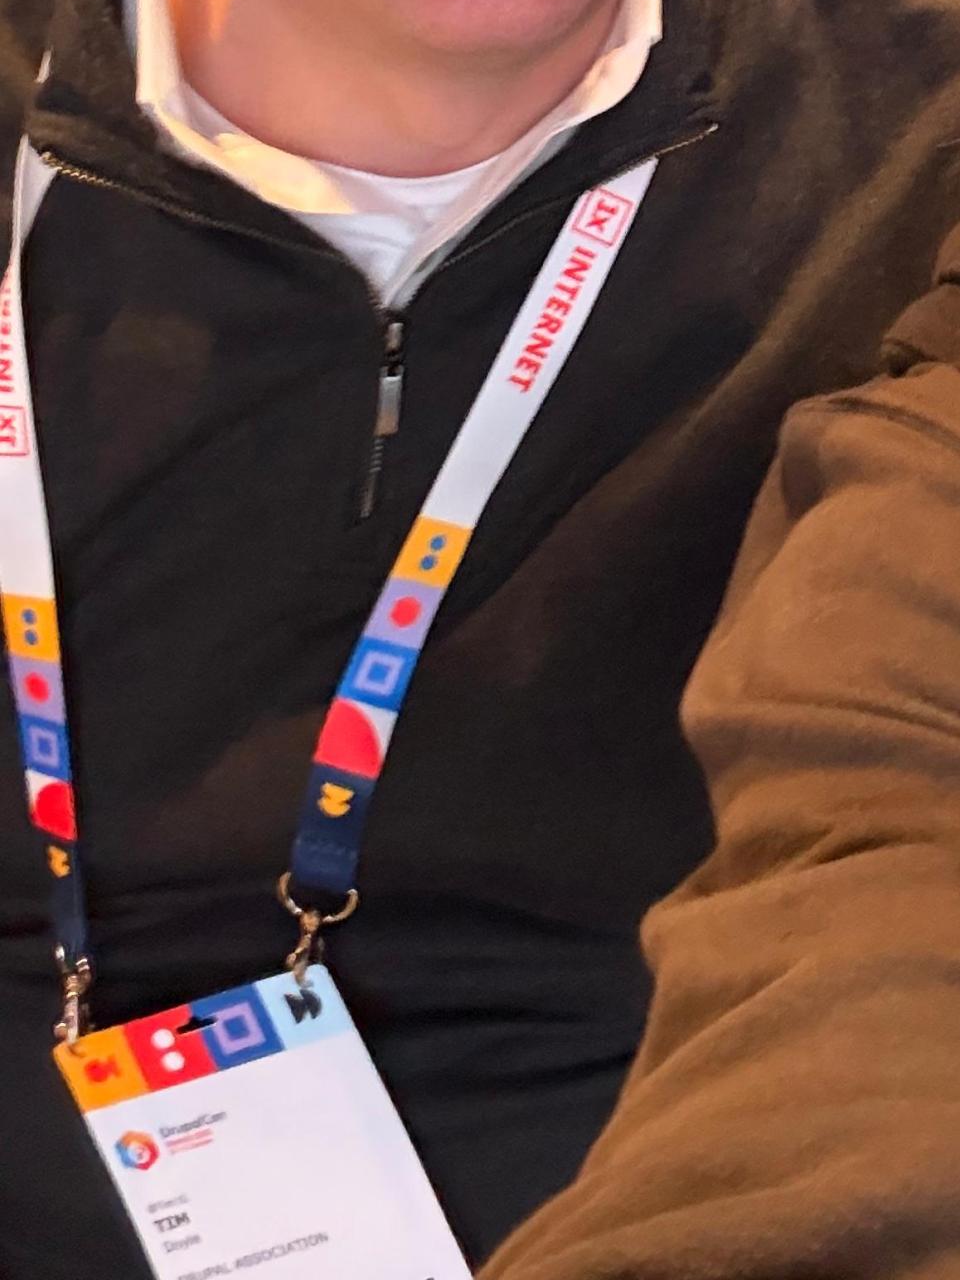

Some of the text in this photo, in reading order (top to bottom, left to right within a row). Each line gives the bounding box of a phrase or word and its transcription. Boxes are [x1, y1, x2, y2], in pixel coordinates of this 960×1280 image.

[506, 245, 598, 394] INTERNET
[153, 1212, 191, 1233] TIM
[234, 1231, 330, 1270] ASSOCIATION
